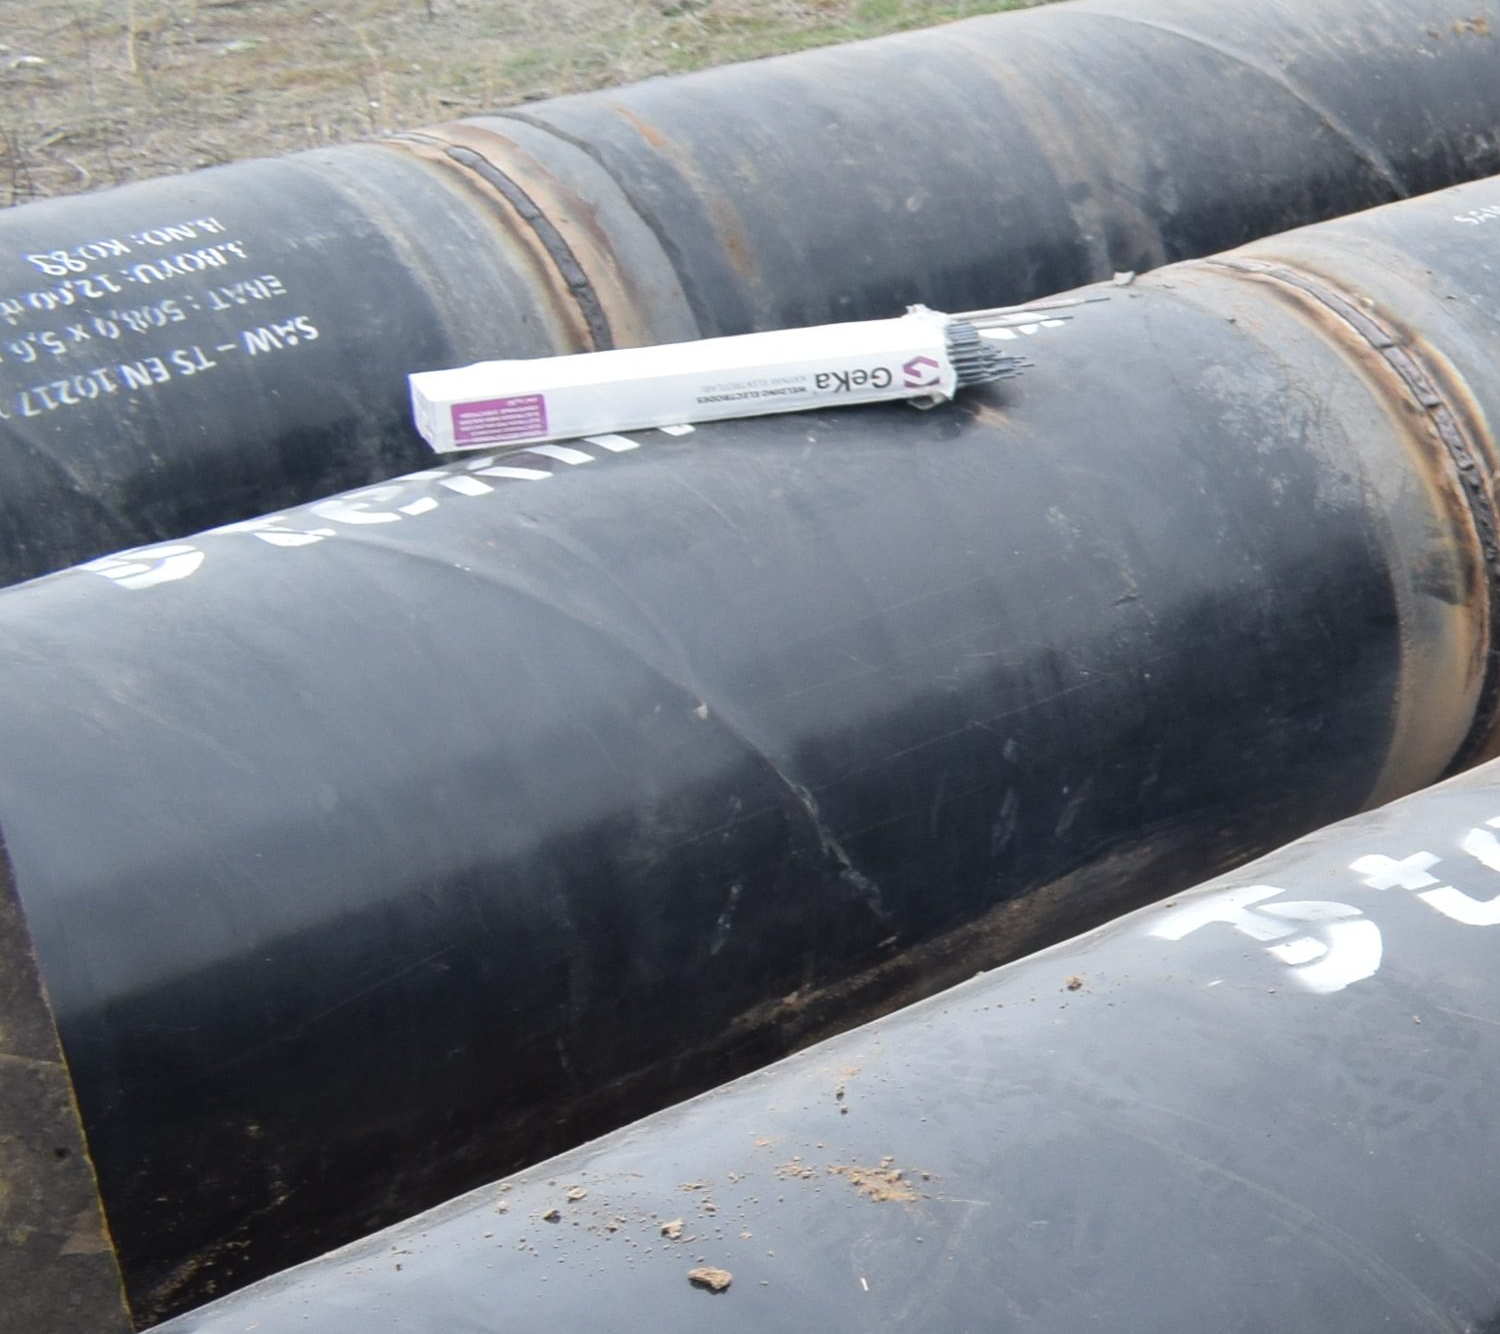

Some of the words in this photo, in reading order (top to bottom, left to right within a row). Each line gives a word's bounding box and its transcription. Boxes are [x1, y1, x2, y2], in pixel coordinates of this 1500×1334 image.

[241, 315, 320, 357] SAW
[119, 356, 172, 391] EN
[171, 345, 217, 376] TS
[814, 366, 893, 393] GeKa
